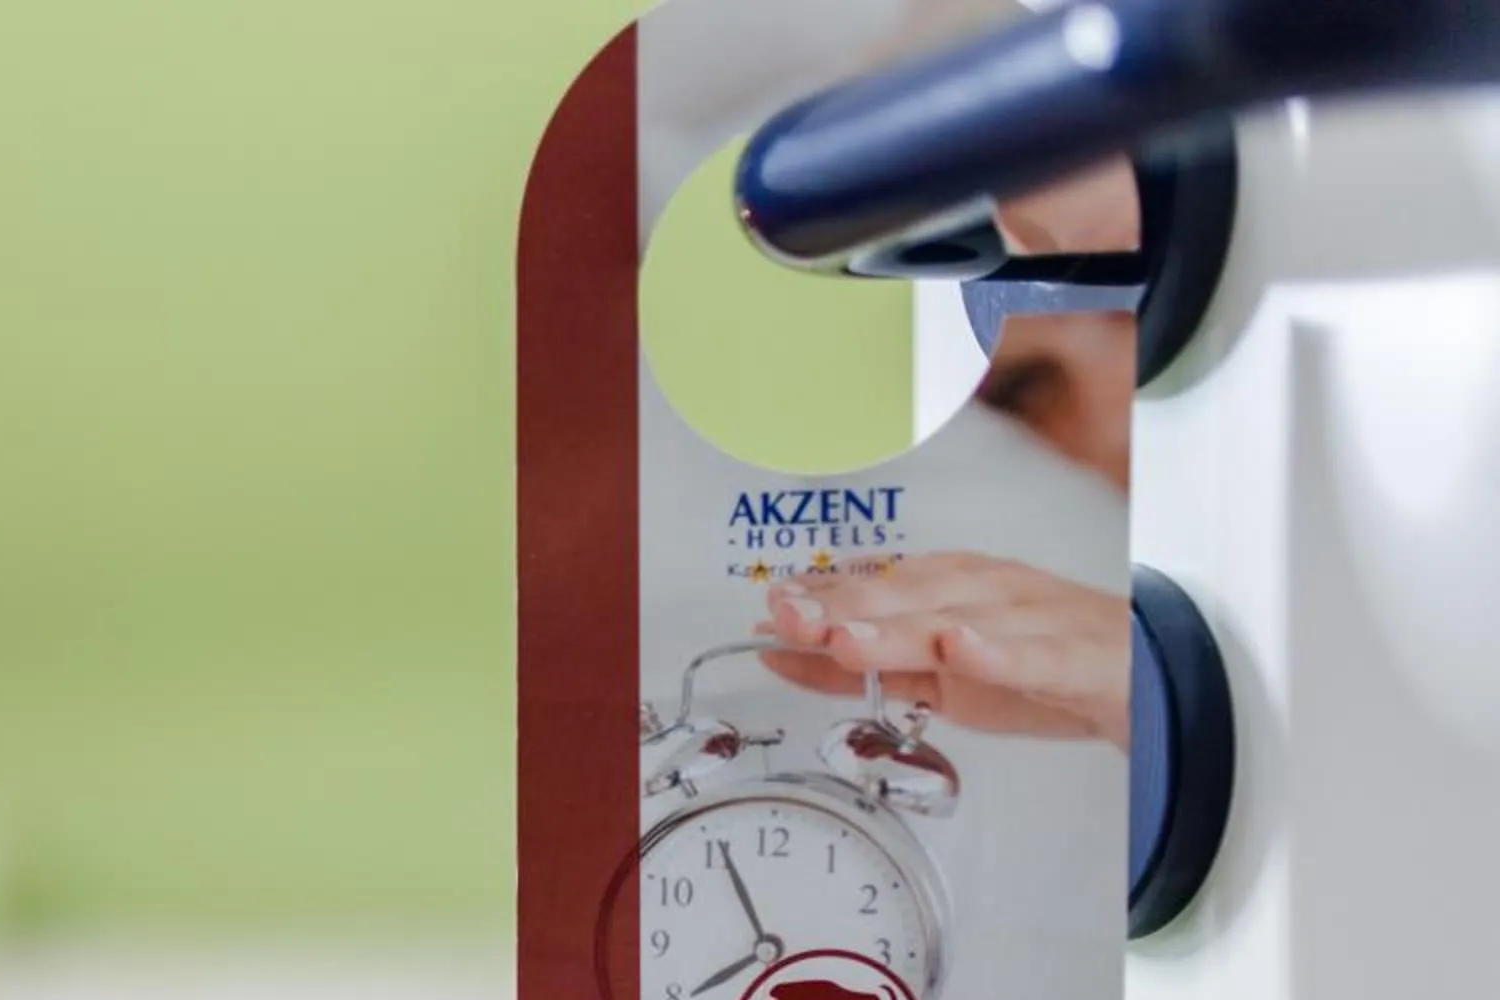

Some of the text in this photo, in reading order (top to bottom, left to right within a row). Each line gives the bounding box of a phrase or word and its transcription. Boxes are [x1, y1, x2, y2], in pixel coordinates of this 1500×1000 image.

[729, 487, 905, 527] AKZENT
[756, 827, 790, 858] 12
[826, 844, 836, 874] 1
[659, 876, 694, 908] 10
[858, 884, 879, 915] 2
[650, 930, 671, 959] 9
[875, 938, 892, 966] 3
